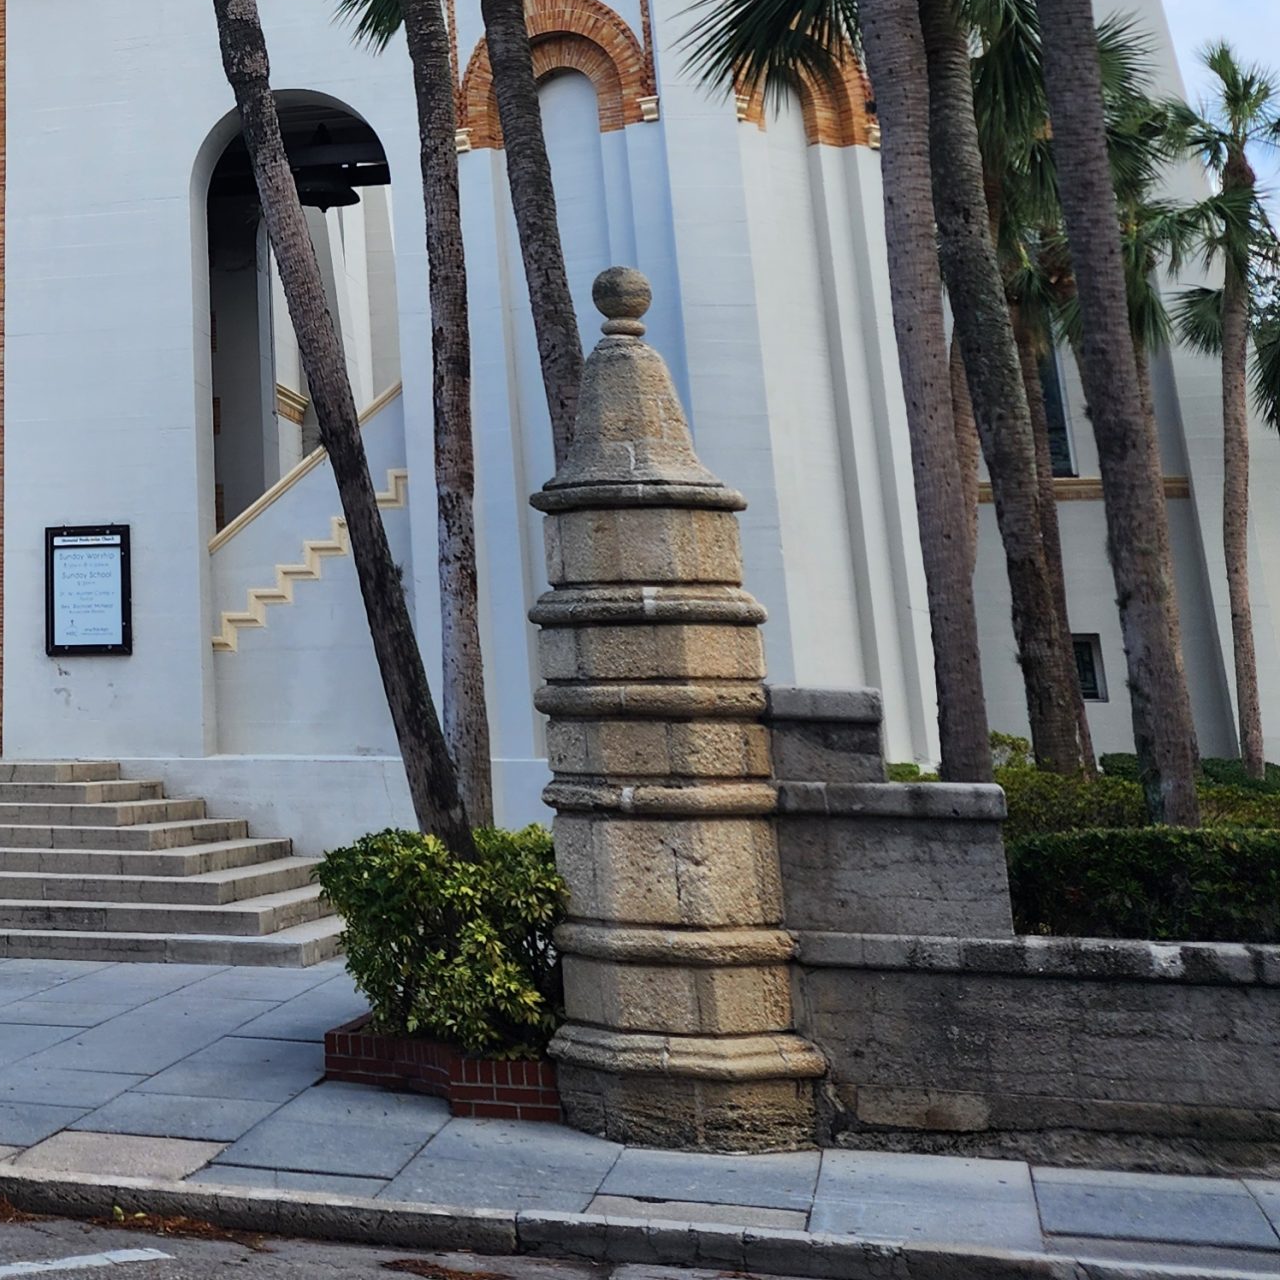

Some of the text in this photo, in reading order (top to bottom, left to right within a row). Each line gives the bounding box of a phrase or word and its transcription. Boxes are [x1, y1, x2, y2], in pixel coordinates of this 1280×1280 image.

[59, 553, 84, 561] Sunday
[62, 570, 112, 580] Sunday School
